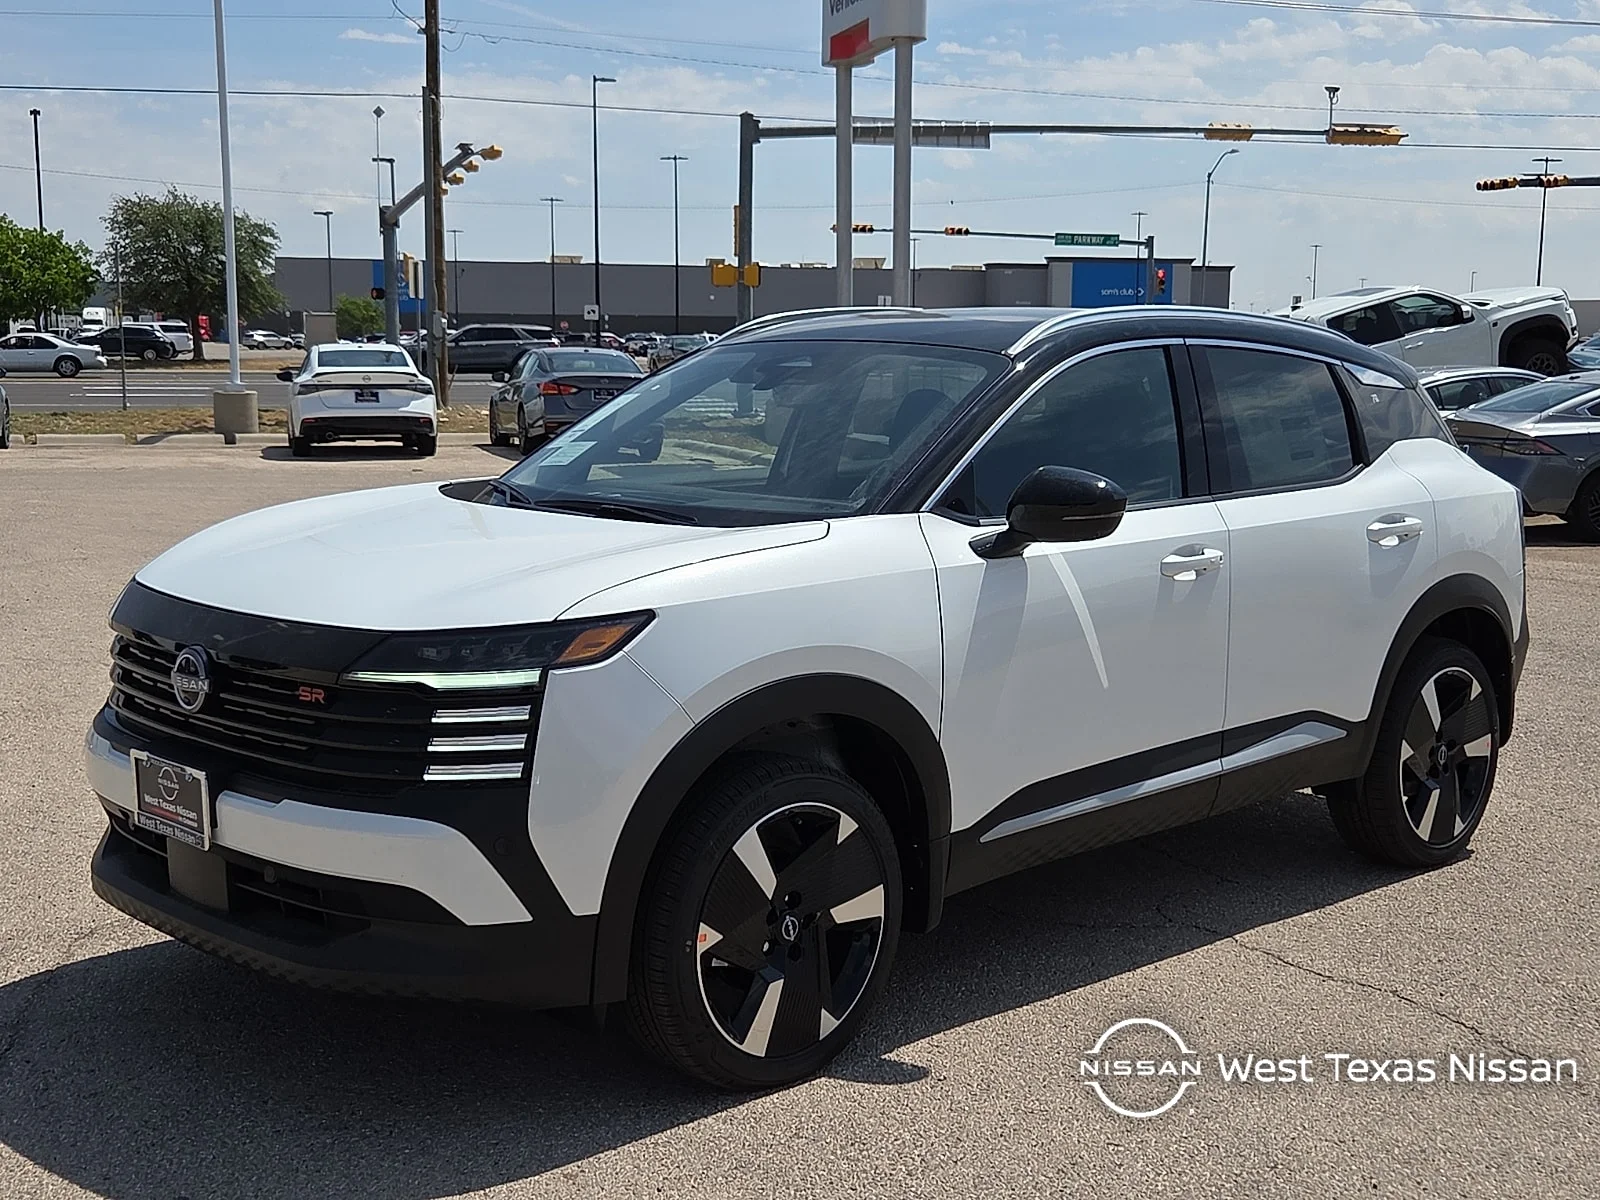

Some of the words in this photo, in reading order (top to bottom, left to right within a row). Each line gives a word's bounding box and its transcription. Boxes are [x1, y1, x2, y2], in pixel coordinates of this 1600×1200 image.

[1074, 235, 1105, 245] PARKWAY
[1101, 288, 1118, 296] sam's
[1119, 287, 1135, 296] club
[298, 686, 325, 704] SR
[144, 793, 158, 806] West
[159, 799, 176, 813] Texas
[177, 805, 198, 820] Nissan
[140, 814, 155, 829] West
[156, 820, 173, 835] Texas
[174, 827, 195, 844] Nissan
